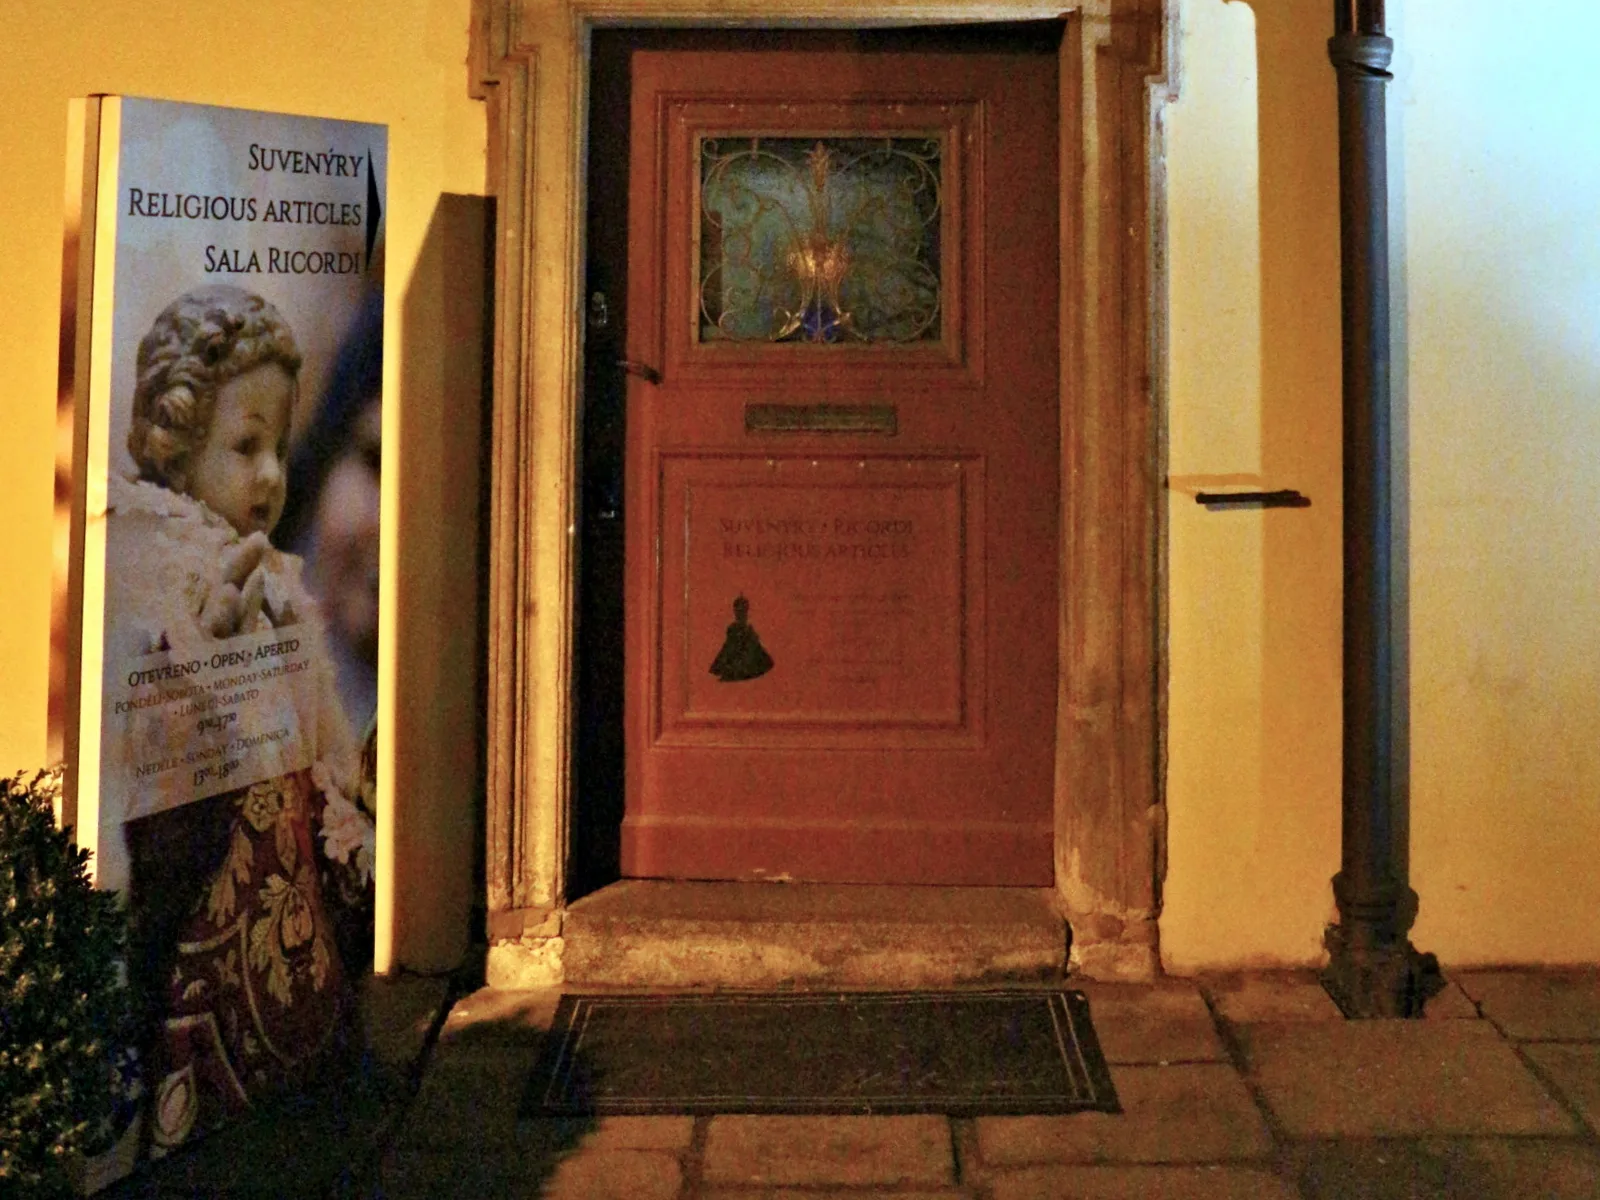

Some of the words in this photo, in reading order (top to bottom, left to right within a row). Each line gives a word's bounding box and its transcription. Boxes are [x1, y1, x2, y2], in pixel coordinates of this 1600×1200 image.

[248, 143, 363, 177] SUVENÝRY
[128, 188, 257, 222] RELIGIOUS
[262, 200, 362, 226] ARTICLES
[204, 245, 262, 273] SALA
[268, 247, 361, 275] RICORDI
[211, 650, 246, 669] OPEN
[254, 639, 300, 661] APERTO
